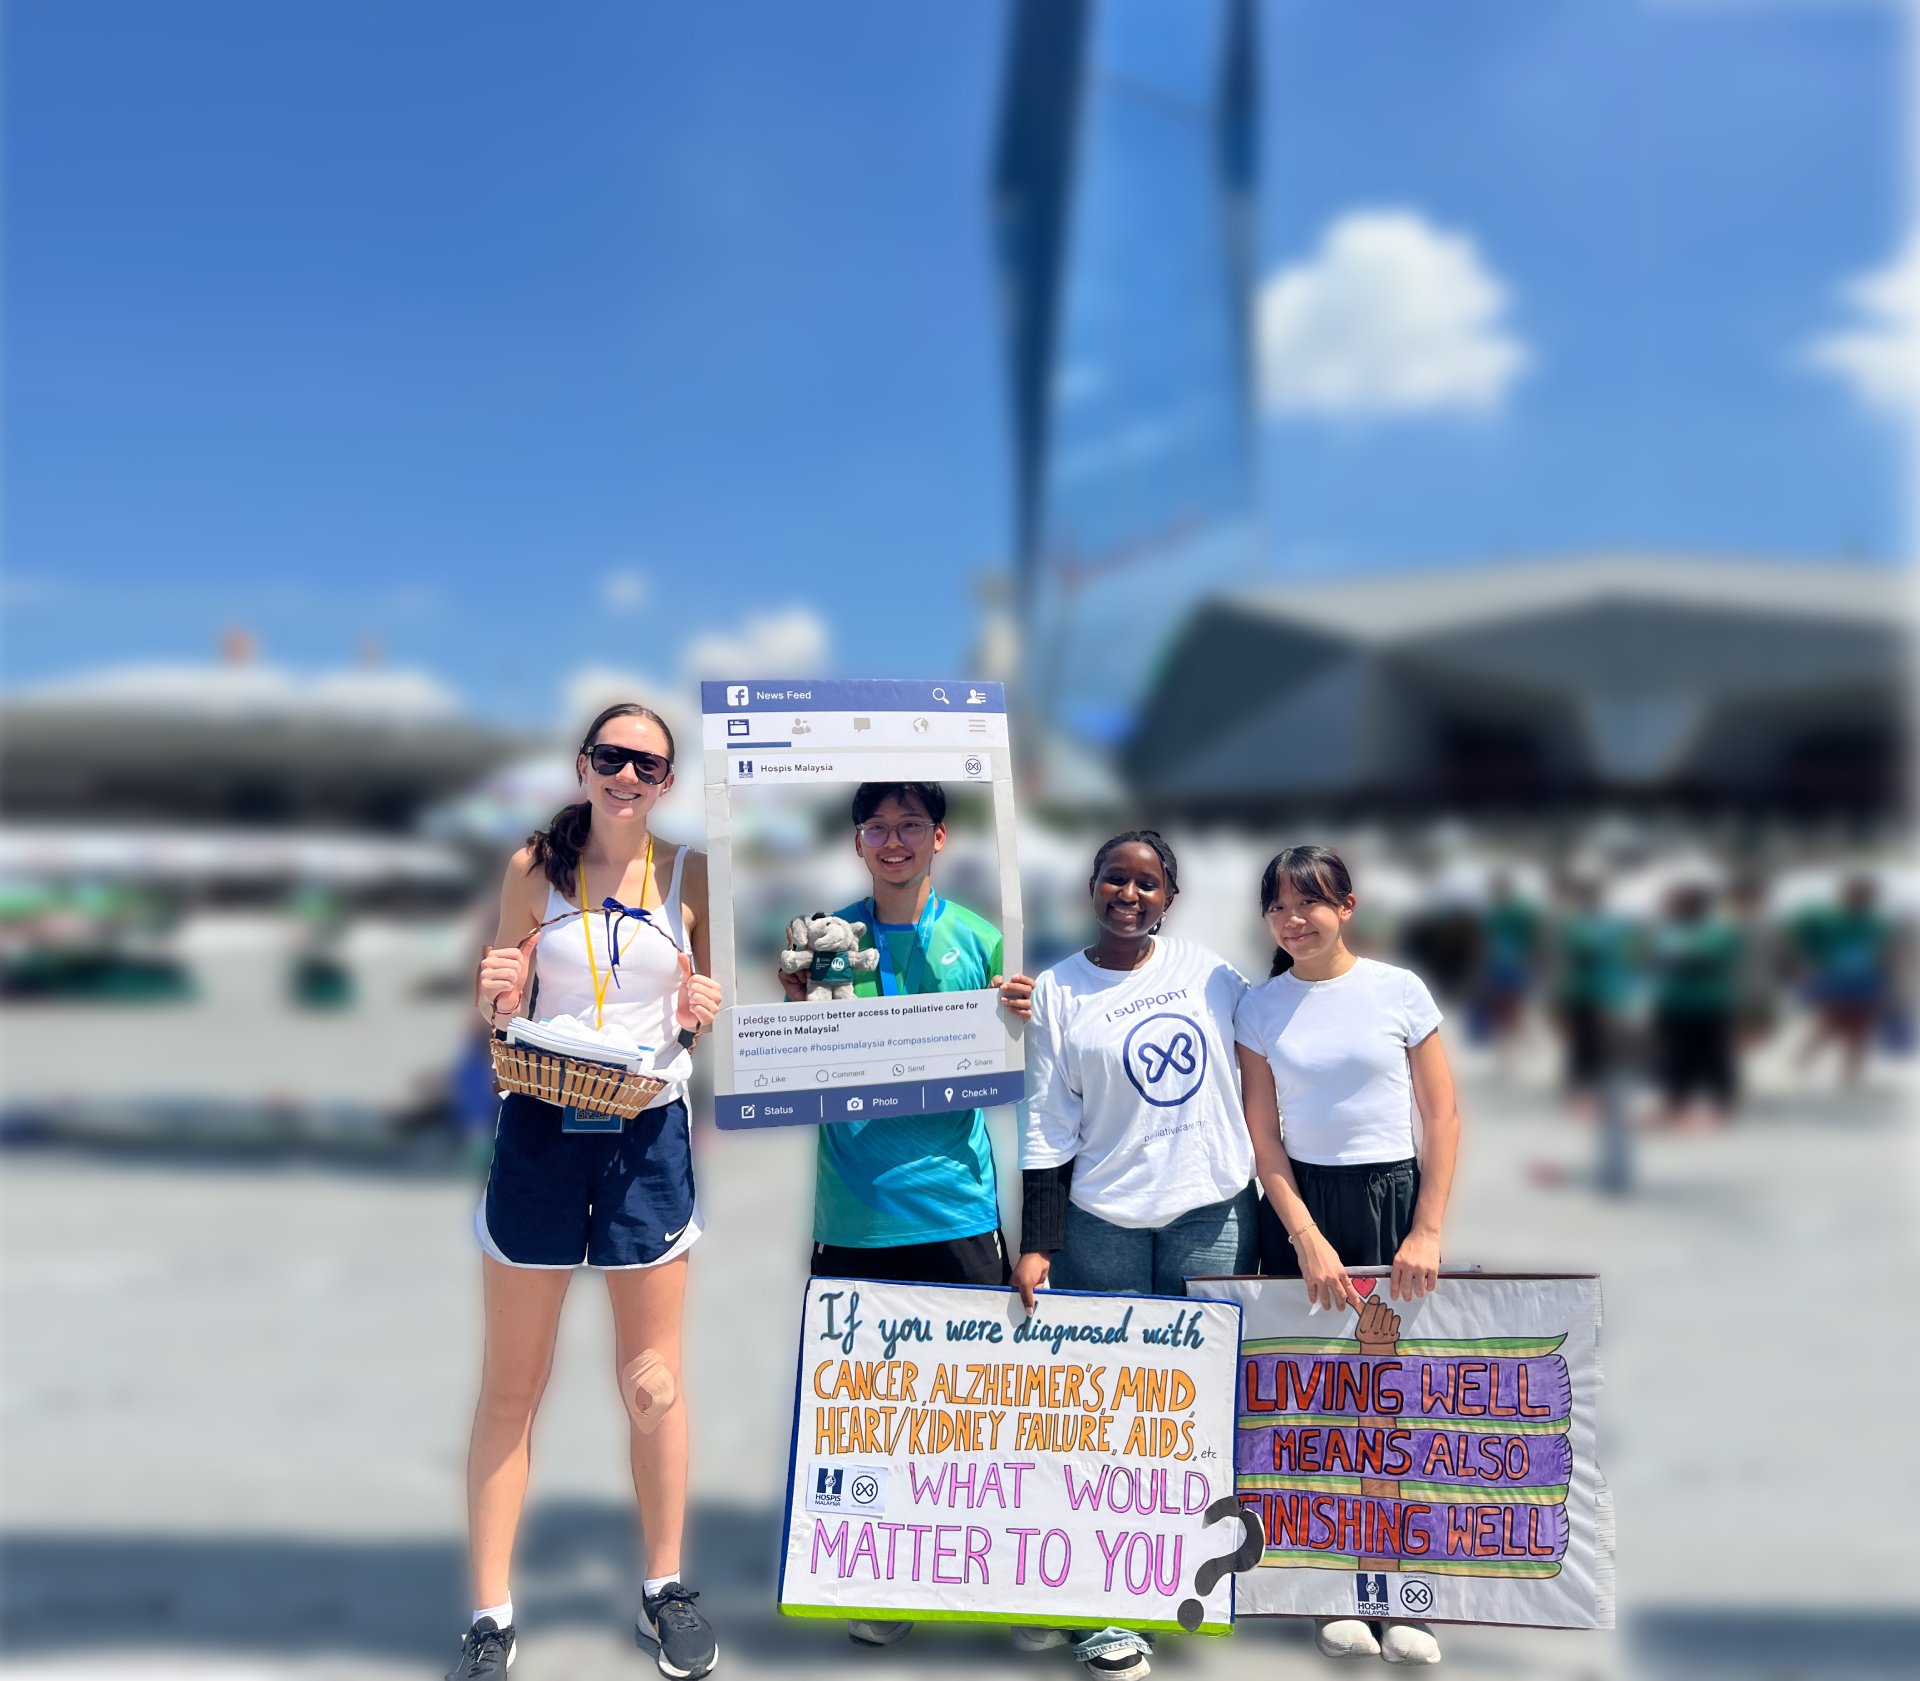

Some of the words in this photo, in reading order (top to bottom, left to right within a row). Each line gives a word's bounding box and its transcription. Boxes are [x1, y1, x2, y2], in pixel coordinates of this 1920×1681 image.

[756, 691, 784, 700] News
[786, 690, 812, 699] Feed
[760, 764, 792, 773] Hospis
[794, 764, 833, 773] Malaysia
[743, 1016, 775, 1026] pledge
[778, 1014, 787, 1022] to
[789, 1012, 825, 1023] support
[827, 1010, 856, 1019] better
[858, 1009, 889, 1018] access
[891, 1007, 900, 1015] to
[902, 1004, 943, 1015] palliative
[966, 1001, 978, 1009] for
[1105, 1013, 1111, 1022] I
[1114, 988, 1187, 1018] SUPPORT
[738, 1029, 782, 1039] everyone
[784, 1027, 792, 1035] in
[794, 1024, 840, 1035] Malaysia!
[739, 1044, 808, 1057] #palliativecare
[810, 1039, 885, 1052] #hospismalaysia
[887, 1032, 976, 1045] #compassionatecare
[832, 1070, 865, 1078] Comment
[872, 1097, 898, 1106] Photo
[962, 1088, 988, 1098] Check
[990, 1087, 998, 1095] In
[765, 1106, 794, 1115] Status
[818, 1290, 862, 1355] If
[878, 1315, 933, 1360] you
[946, 1317, 1003, 1344] were
[1013, 1300, 1133, 1355] diagnosed
[1142, 1308, 1205, 1350] with
[1246, 1360, 1404, 1414] LIVING
[1421, 1362, 1550, 1417] WELL
[815, 1405, 1006, 1456] HEART/KIDNEY
[1015, 1412, 1117, 1456] FAILURE,
[1201, 1448, 1218, 1460] etc
[1273, 1429, 1412, 1475] MEANS
[1423, 1433, 1530, 1480] ALSO
[815, 1493, 841, 1502] HOSPIS
[908, 1462, 1035, 1509] WHAT
[1063, 1464, 1209, 1516] WOULD
[1447, 1505, 1554, 1557] WELL
[810, 1518, 992, 1585] MATTER
[1006, 1527, 1071, 1588] TO
[1357, 1602, 1390, 1611] HOSPIS
[1358, 1609, 1390, 1617] MALAYSIA
